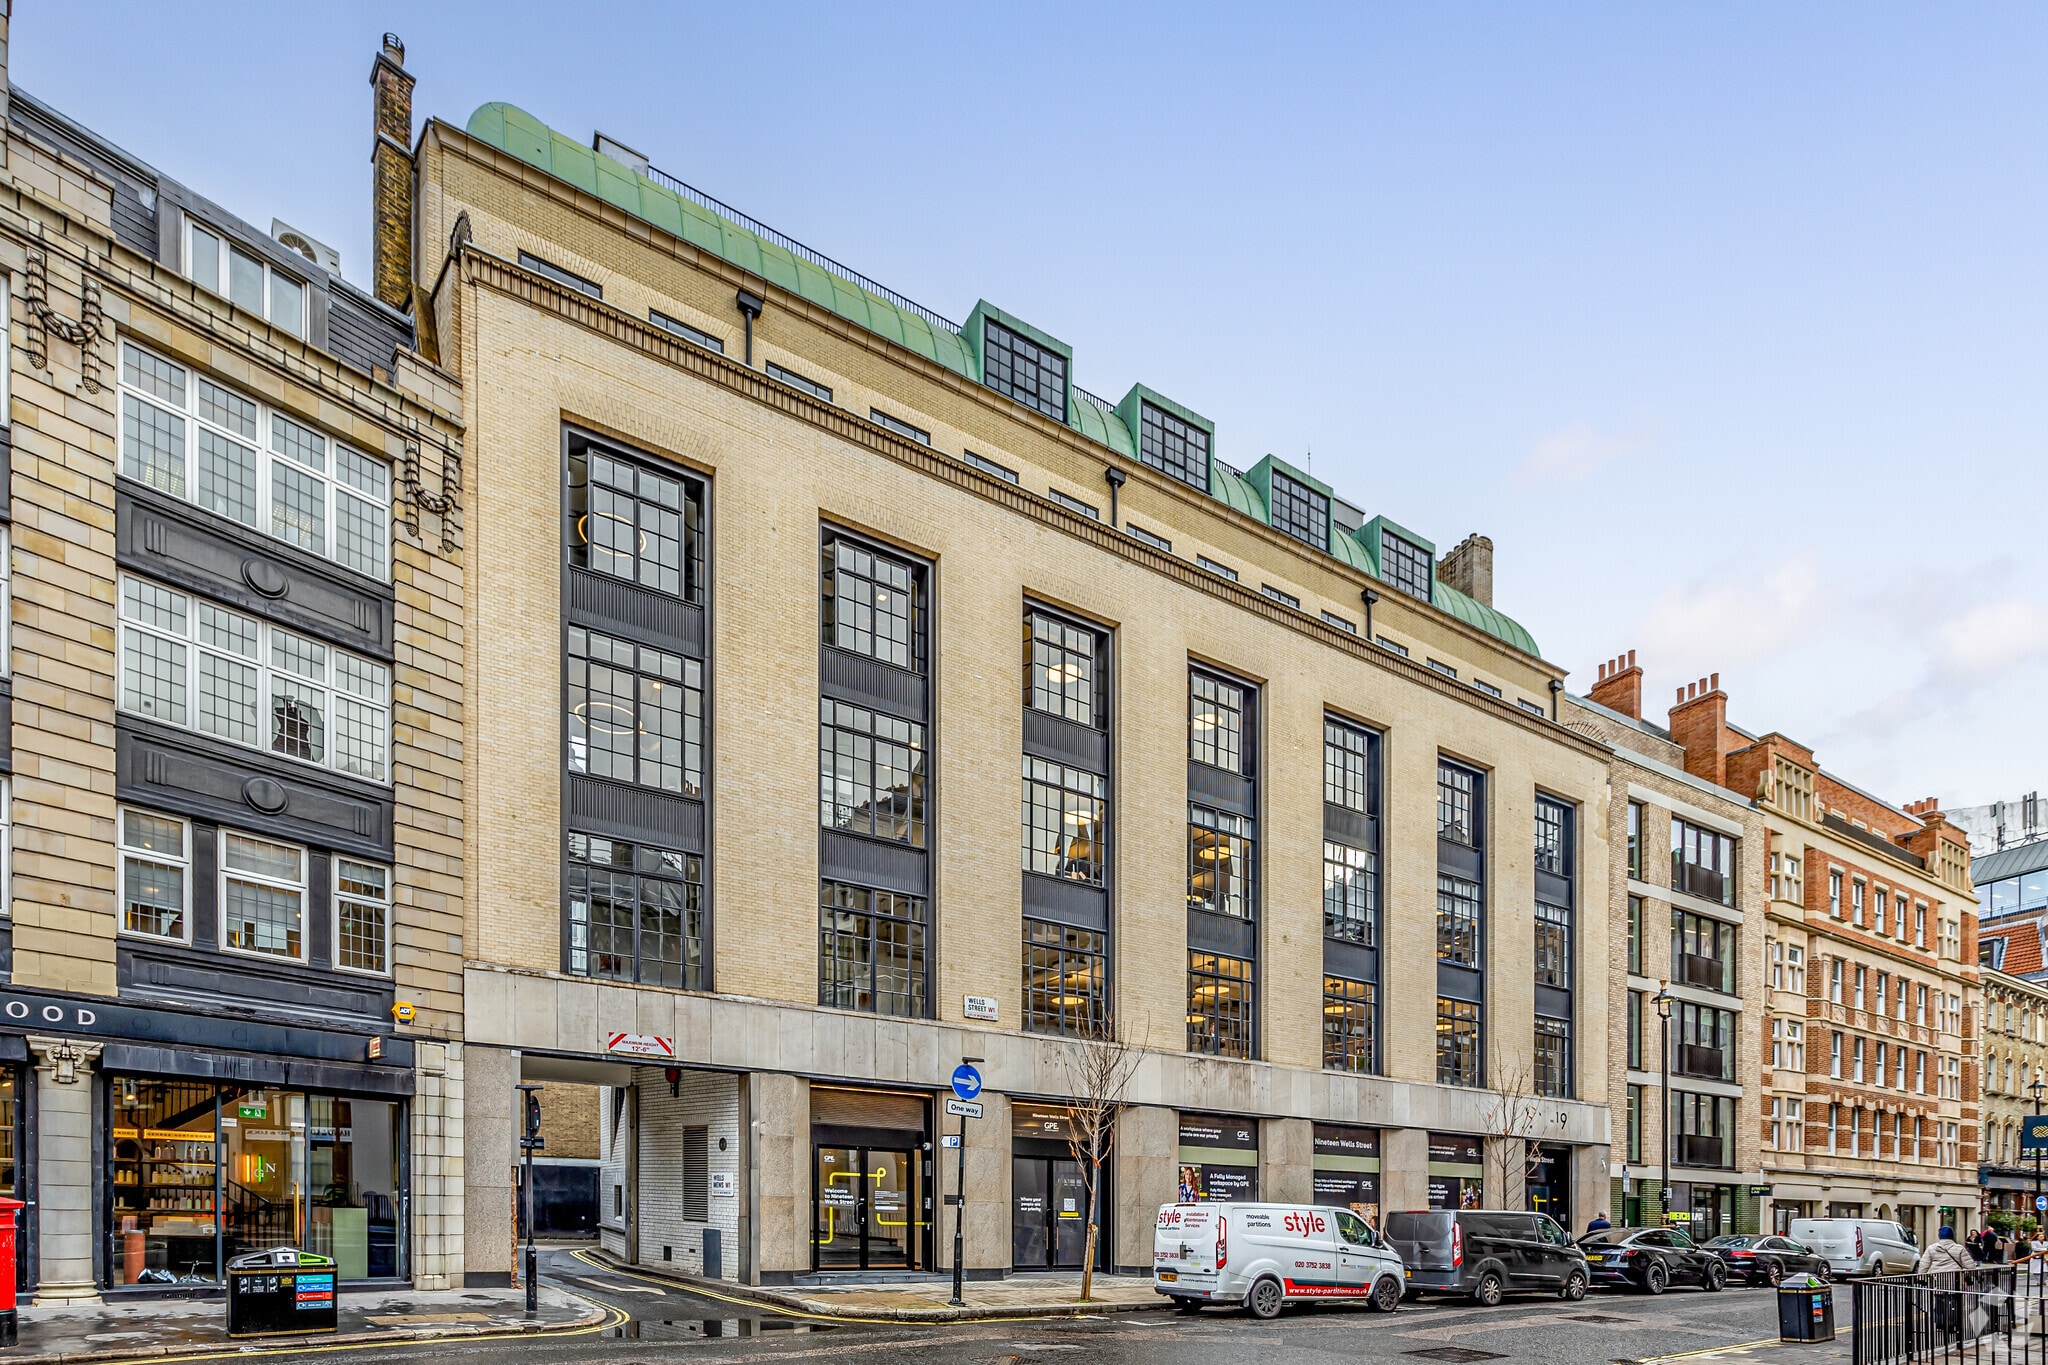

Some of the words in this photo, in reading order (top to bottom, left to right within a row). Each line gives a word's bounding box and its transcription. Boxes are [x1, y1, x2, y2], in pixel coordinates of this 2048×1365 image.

[968, 1004, 987, 1012] STREET
[5, 1001, 96, 1026] OOD
[965, 1106, 979, 1115] way
[1556, 1111, 1567, 1129] 19
[951, 1137, 957, 1146] P
[1314, 1137, 1340, 1147] Nineteen
[1340, 1140, 1355, 1148] Wells
[1355, 1141, 1372, 1149] Street
[266, 1163, 276, 1173] N
[1233, 1180, 1240, 1188] by
[1158, 1209, 1181, 1227] style
[1284, 1210, 1326, 1238] style
[1305, 1261, 1317, 1269] 3752
[1318, 1262, 1331, 1270] 3838
[1288, 1287, 1366, 1295] www.style-partitions.co.uk
